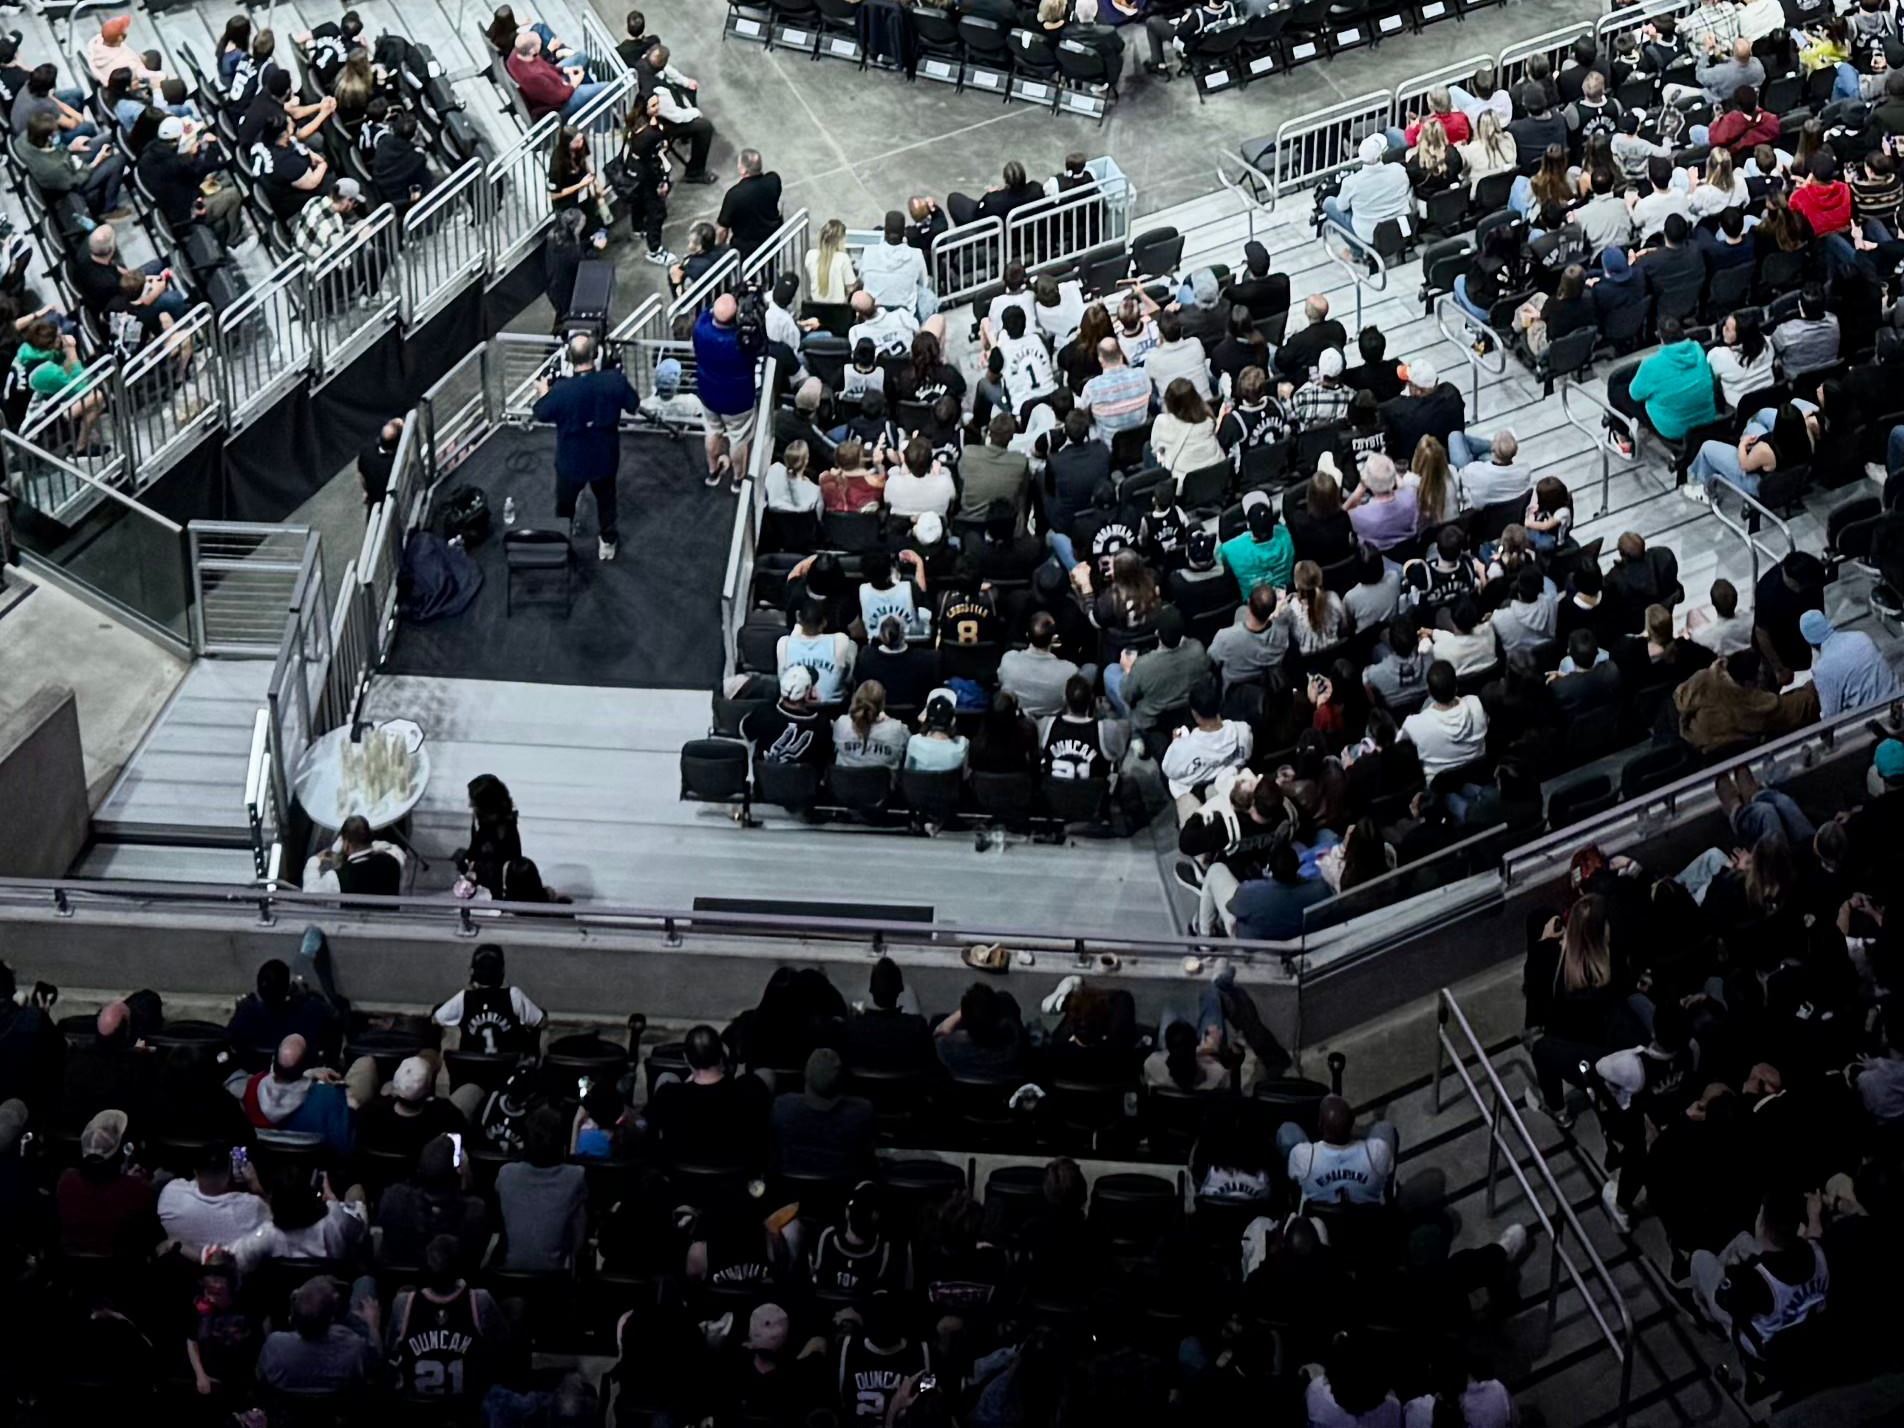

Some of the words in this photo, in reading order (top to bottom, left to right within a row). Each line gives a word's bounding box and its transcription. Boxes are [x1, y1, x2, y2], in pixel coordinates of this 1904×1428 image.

[1025, 364, 1040, 389] 1
[957, 620, 980, 645] 8
[1049, 738, 1098, 761] DUNCAN
[407, 1328, 475, 1356] DUNCAN
[413, 1358, 465, 1395] 21
[854, 1370, 904, 1390] DUNCA
